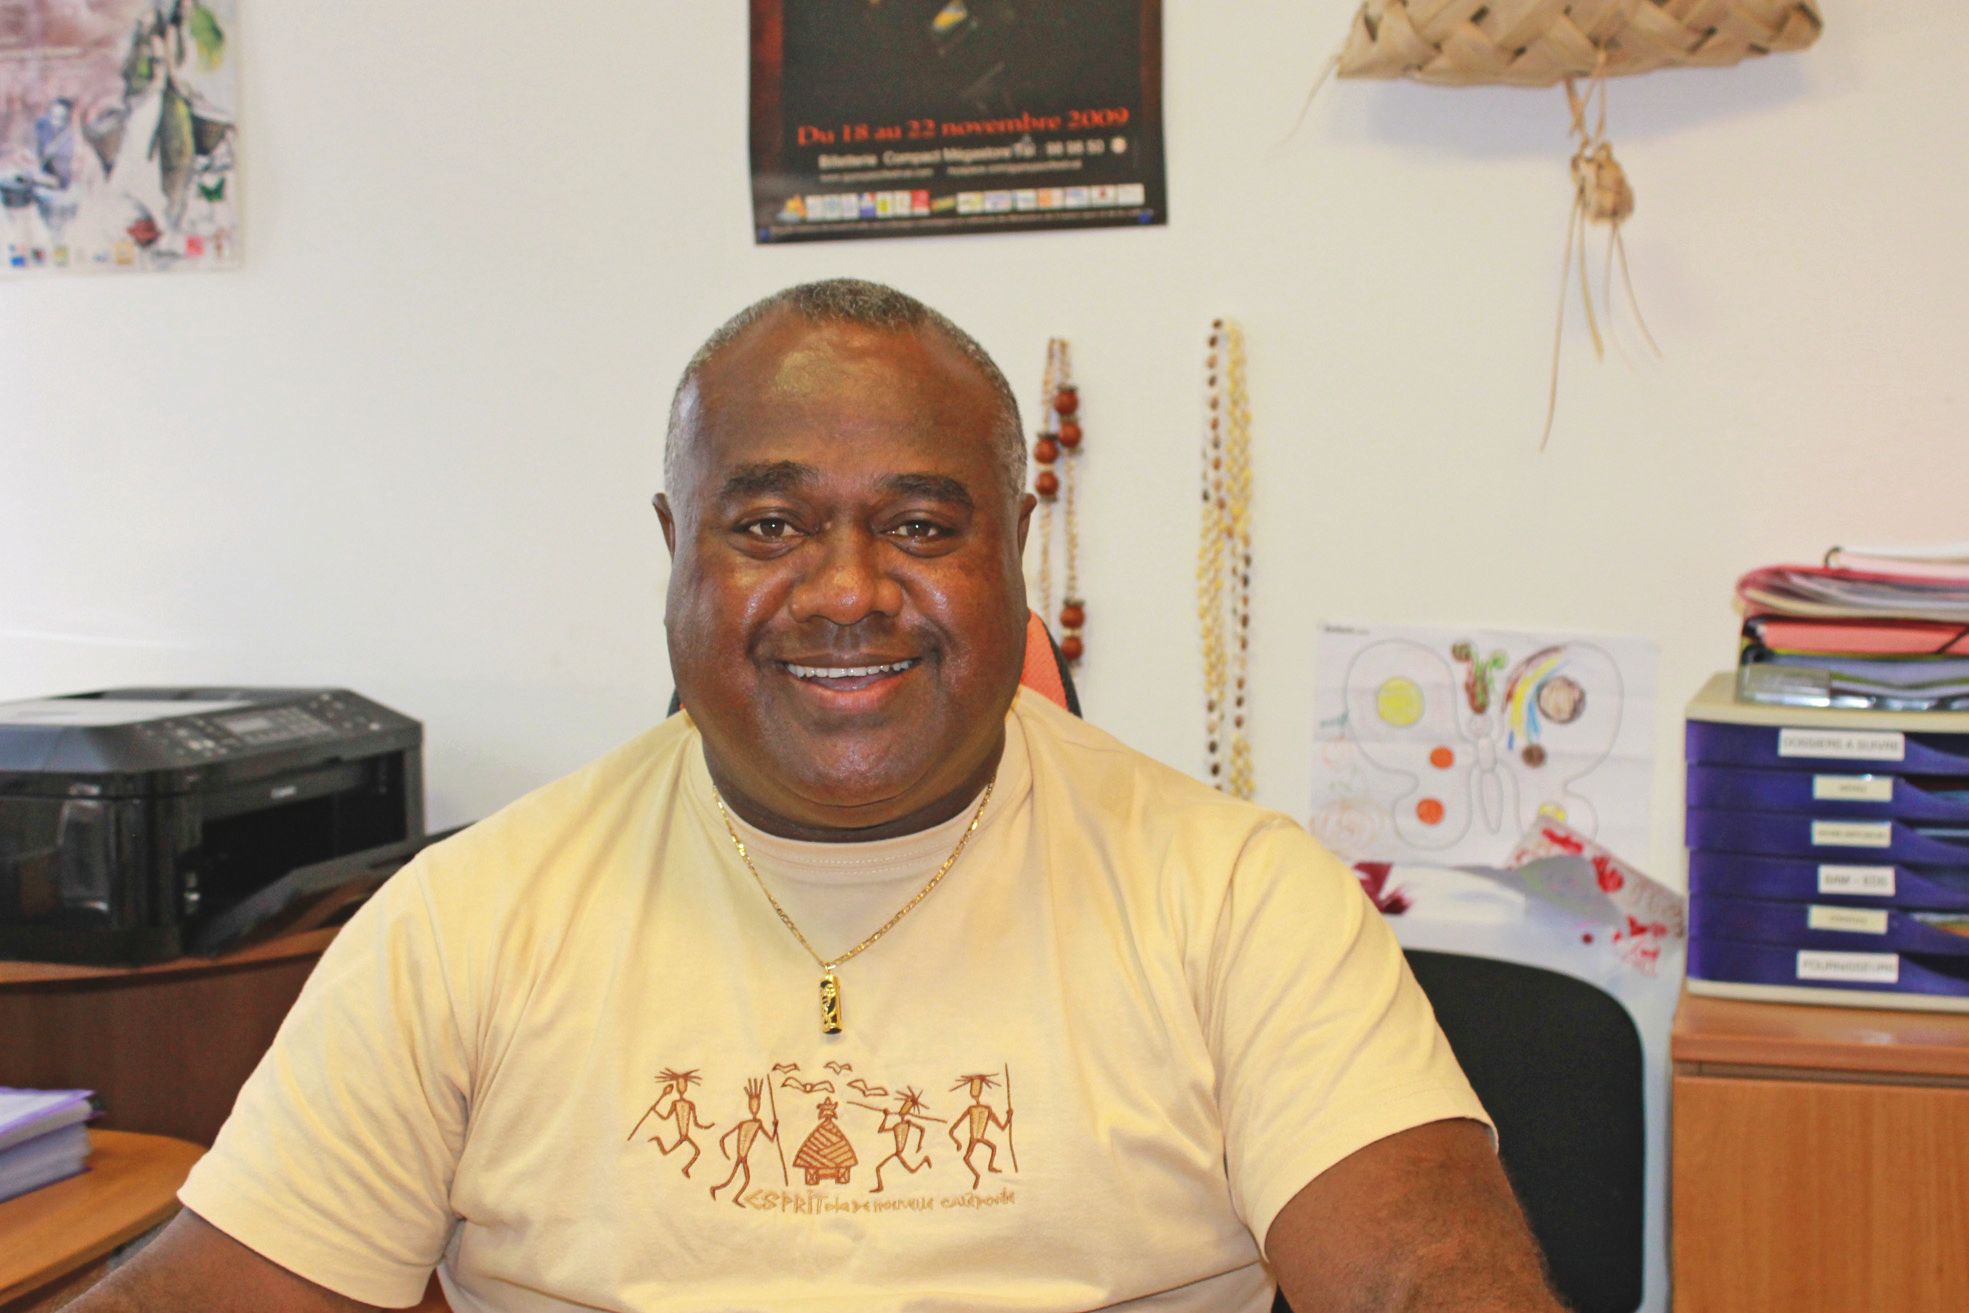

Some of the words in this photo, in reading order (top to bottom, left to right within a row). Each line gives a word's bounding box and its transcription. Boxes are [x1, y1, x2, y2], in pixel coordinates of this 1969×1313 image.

[797, 125, 836, 146] Du
[843, 121, 870, 144] 18
[874, 126, 903, 141] au
[907, 118, 937, 141] 22
[941, 111, 1062, 137] novembre
[1067, 106, 1130, 130] 2009
